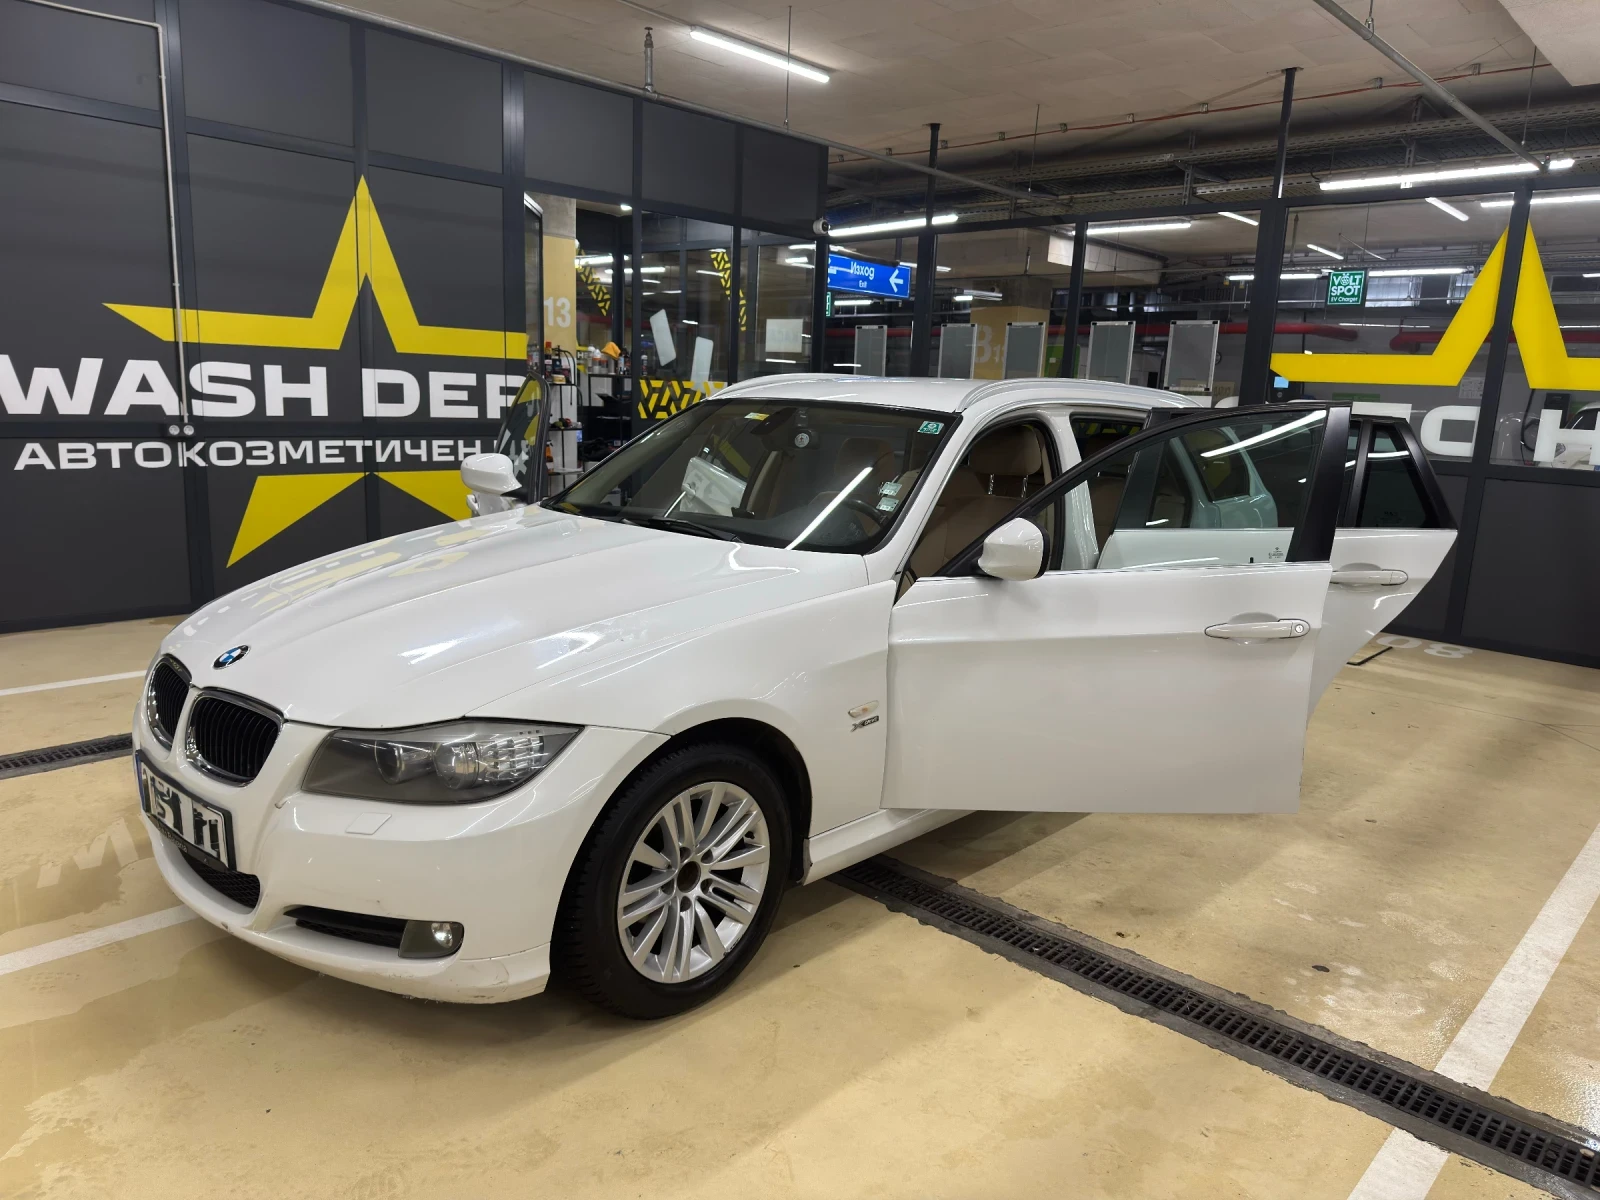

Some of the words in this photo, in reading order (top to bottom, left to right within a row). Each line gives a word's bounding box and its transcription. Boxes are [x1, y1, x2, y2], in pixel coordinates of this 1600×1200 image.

[850, 261, 875, 280] Изход
[1331, 285, 1361, 296] SPOT
[544, 296, 572, 328] 13
[0, 354, 329, 418] WASH
